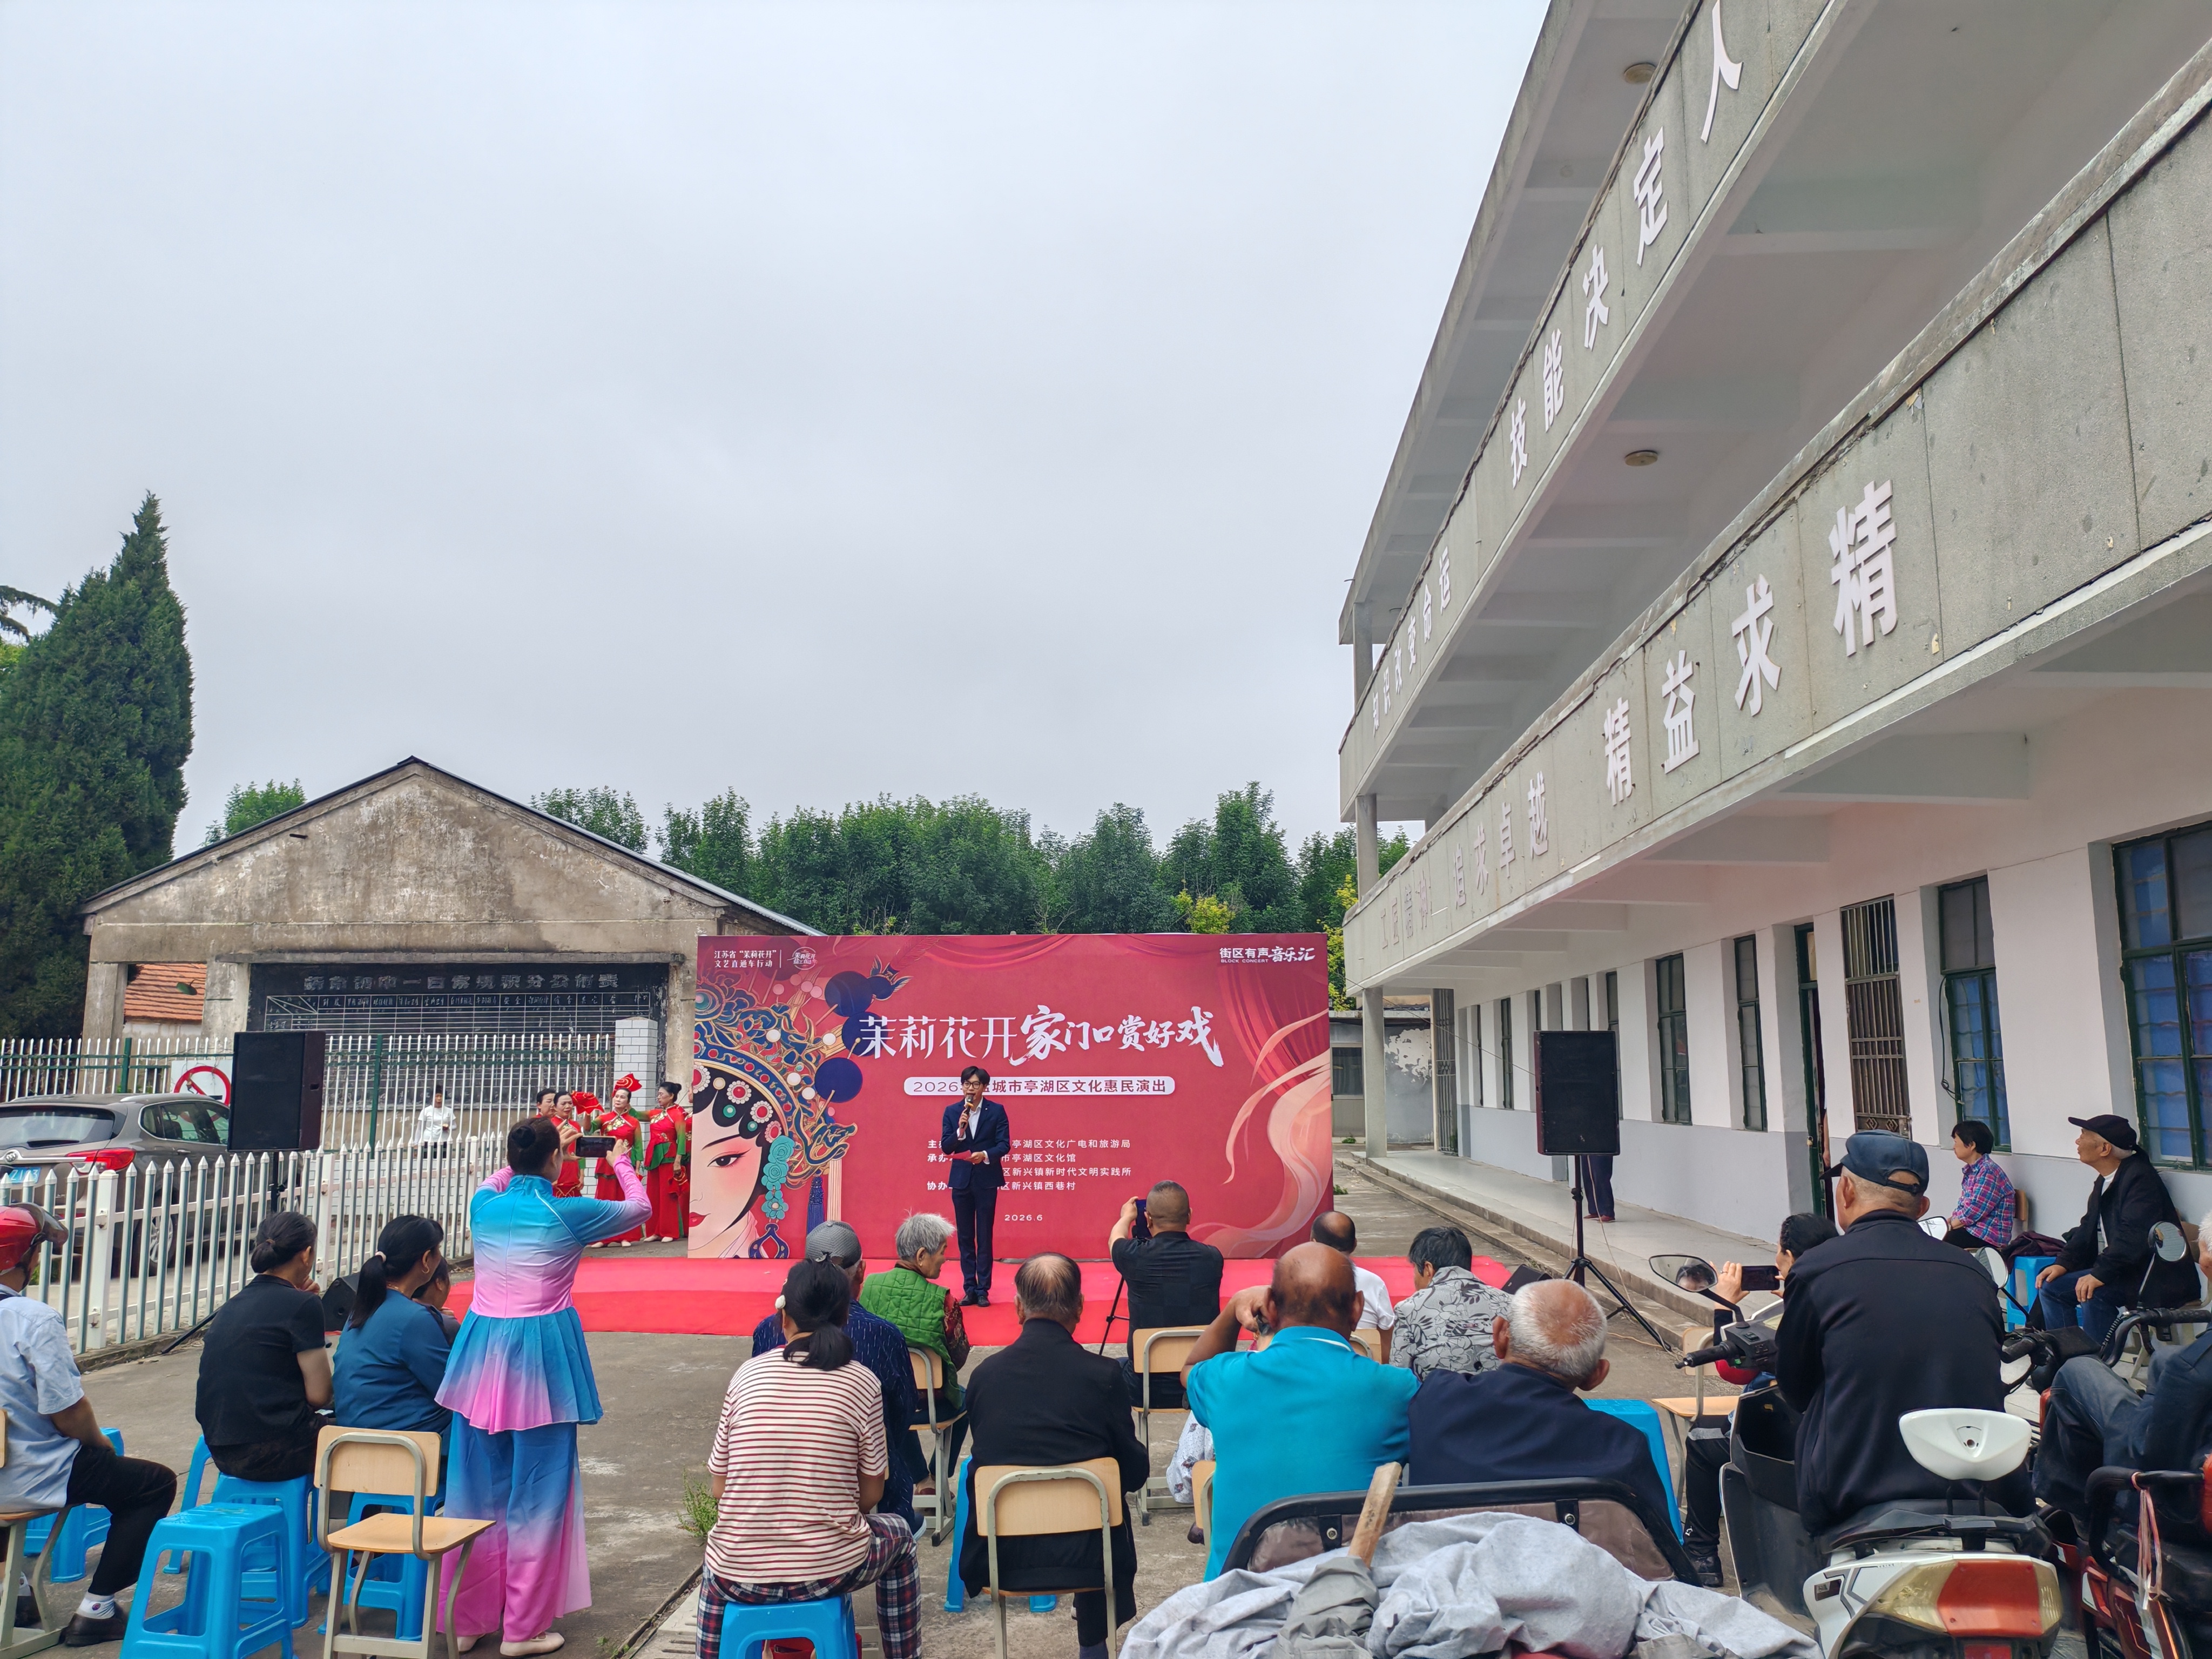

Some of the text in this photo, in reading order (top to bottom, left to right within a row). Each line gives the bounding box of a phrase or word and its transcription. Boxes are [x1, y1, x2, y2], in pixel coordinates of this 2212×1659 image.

[1373, 0, 1744, 738] 知识改变命运 技能决定人
[1453, 771, 1549, 910] 追求卓越
[1603, 480, 1897, 806] 精益求精
[714, 960, 773, 968] 文艺直通车行动
[913, 1080, 1166, 1093] 2026城市亭湖区文化惠民演出
[997, 1181, 1076, 1191] 区新兴镇西巷村
